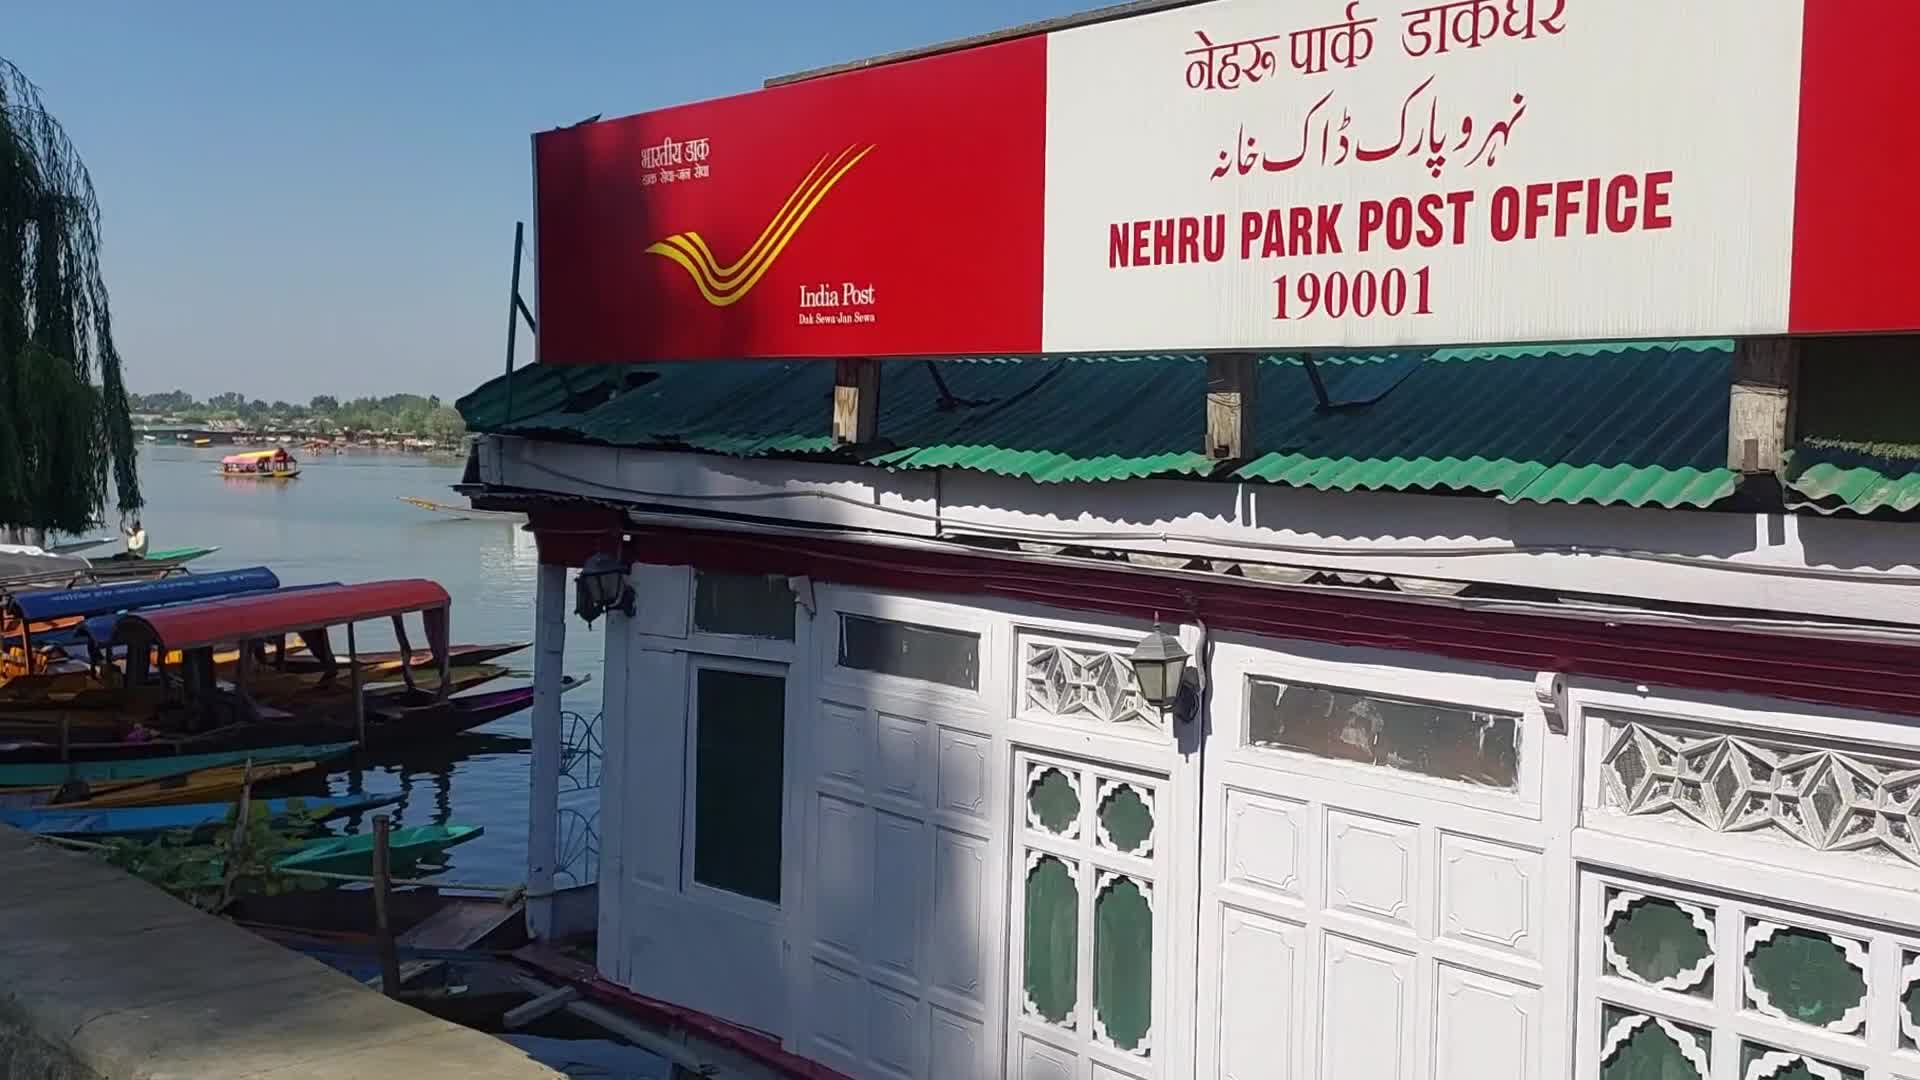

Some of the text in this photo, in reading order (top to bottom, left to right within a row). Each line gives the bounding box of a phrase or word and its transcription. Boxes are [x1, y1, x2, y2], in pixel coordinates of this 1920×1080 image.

[1185, 31, 1280, 90] नेहरू
[1289, 1, 1378, 75] पार्क
[641, 136, 710, 169] भारतीय डाक
[1355, 74, 1447, 178] پارک
[1109, 171, 1674, 268] NEHRU PARK POST OFFICE
[799, 314, 814, 325] Dak
[854, 311, 876, 323] Sewa
[800, 282, 876, 307] India Post
[1273, 265, 1433, 320] 190001
